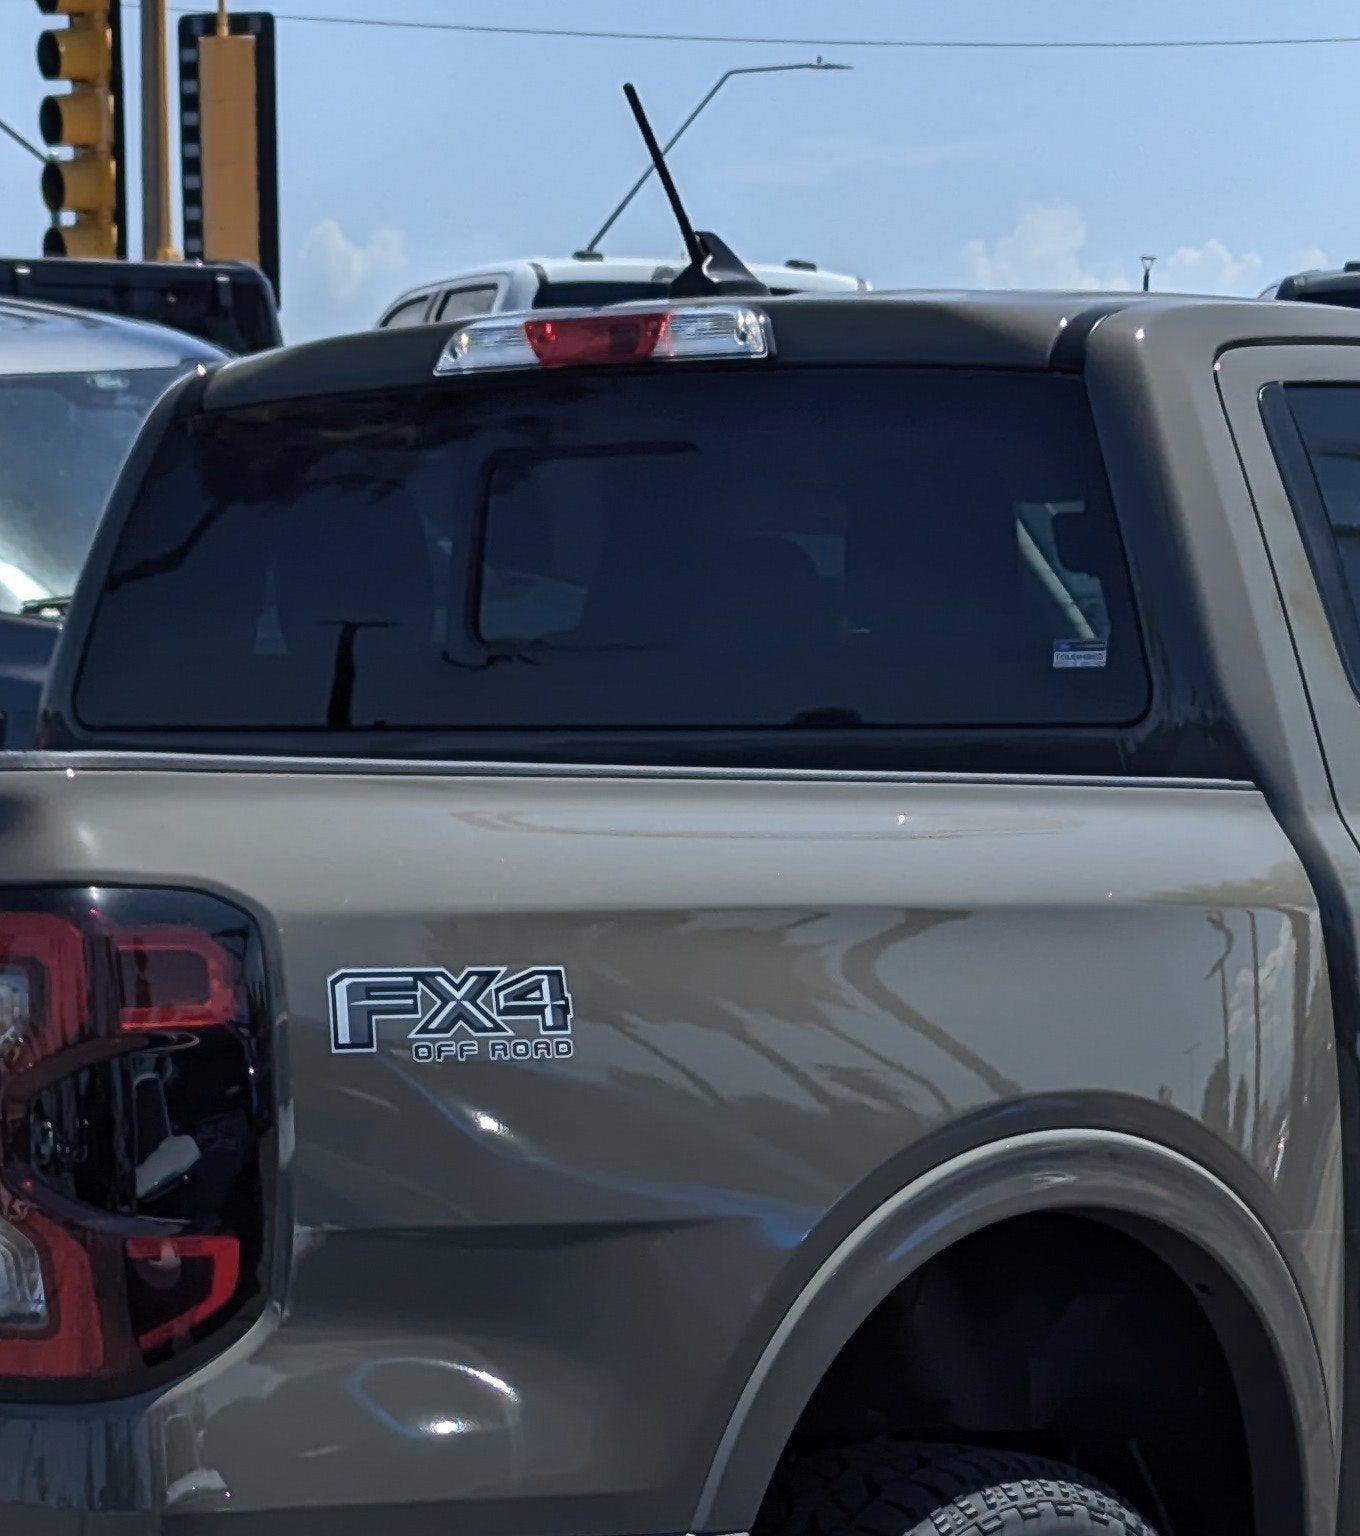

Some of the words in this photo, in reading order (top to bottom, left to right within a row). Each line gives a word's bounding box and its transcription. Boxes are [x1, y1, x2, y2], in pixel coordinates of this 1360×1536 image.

[327, 966, 574, 1053] FX4
[412, 1040, 479, 1063] OFF
[489, 1038, 574, 1060] ROAD
